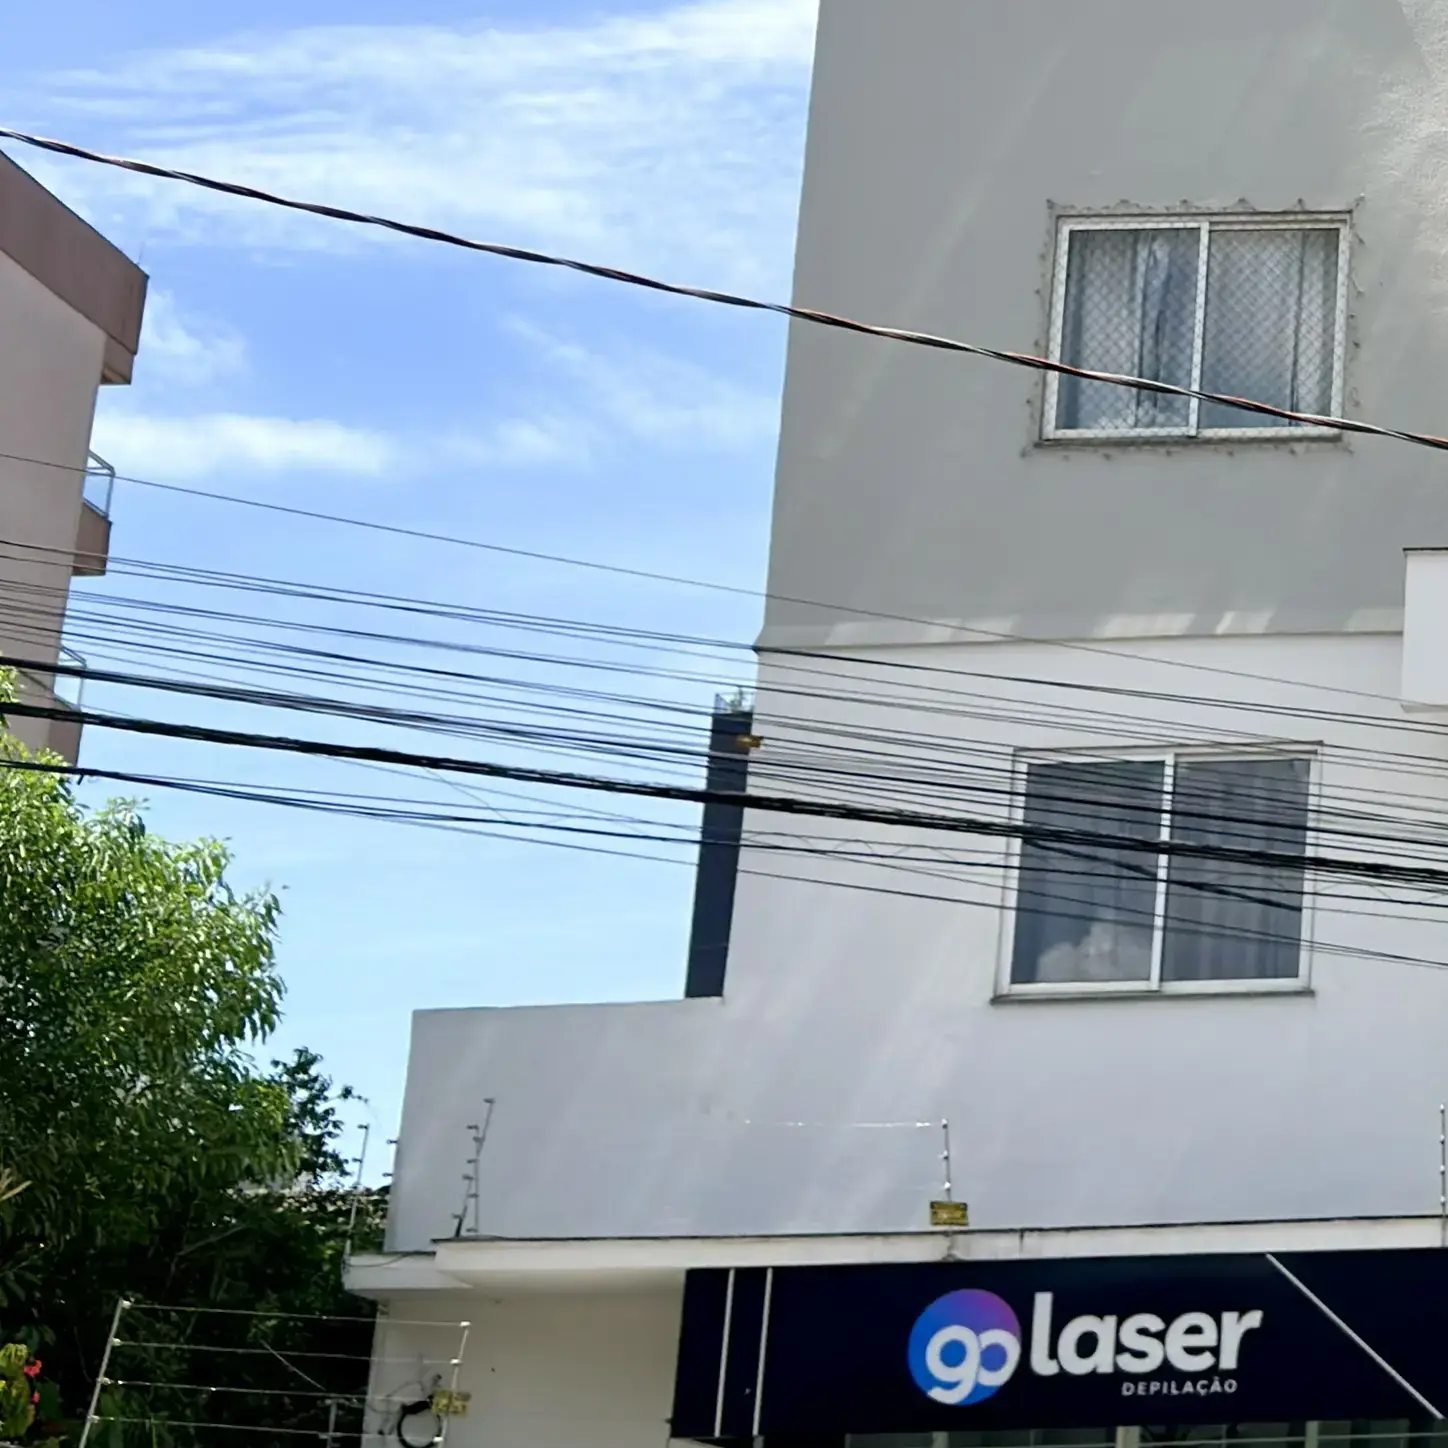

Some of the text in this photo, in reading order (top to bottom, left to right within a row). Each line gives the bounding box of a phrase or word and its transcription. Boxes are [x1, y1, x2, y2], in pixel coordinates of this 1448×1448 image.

[925, 1291, 1264, 1405] go laser
[1121, 1376, 1238, 1396] DEPILAÇÃO
